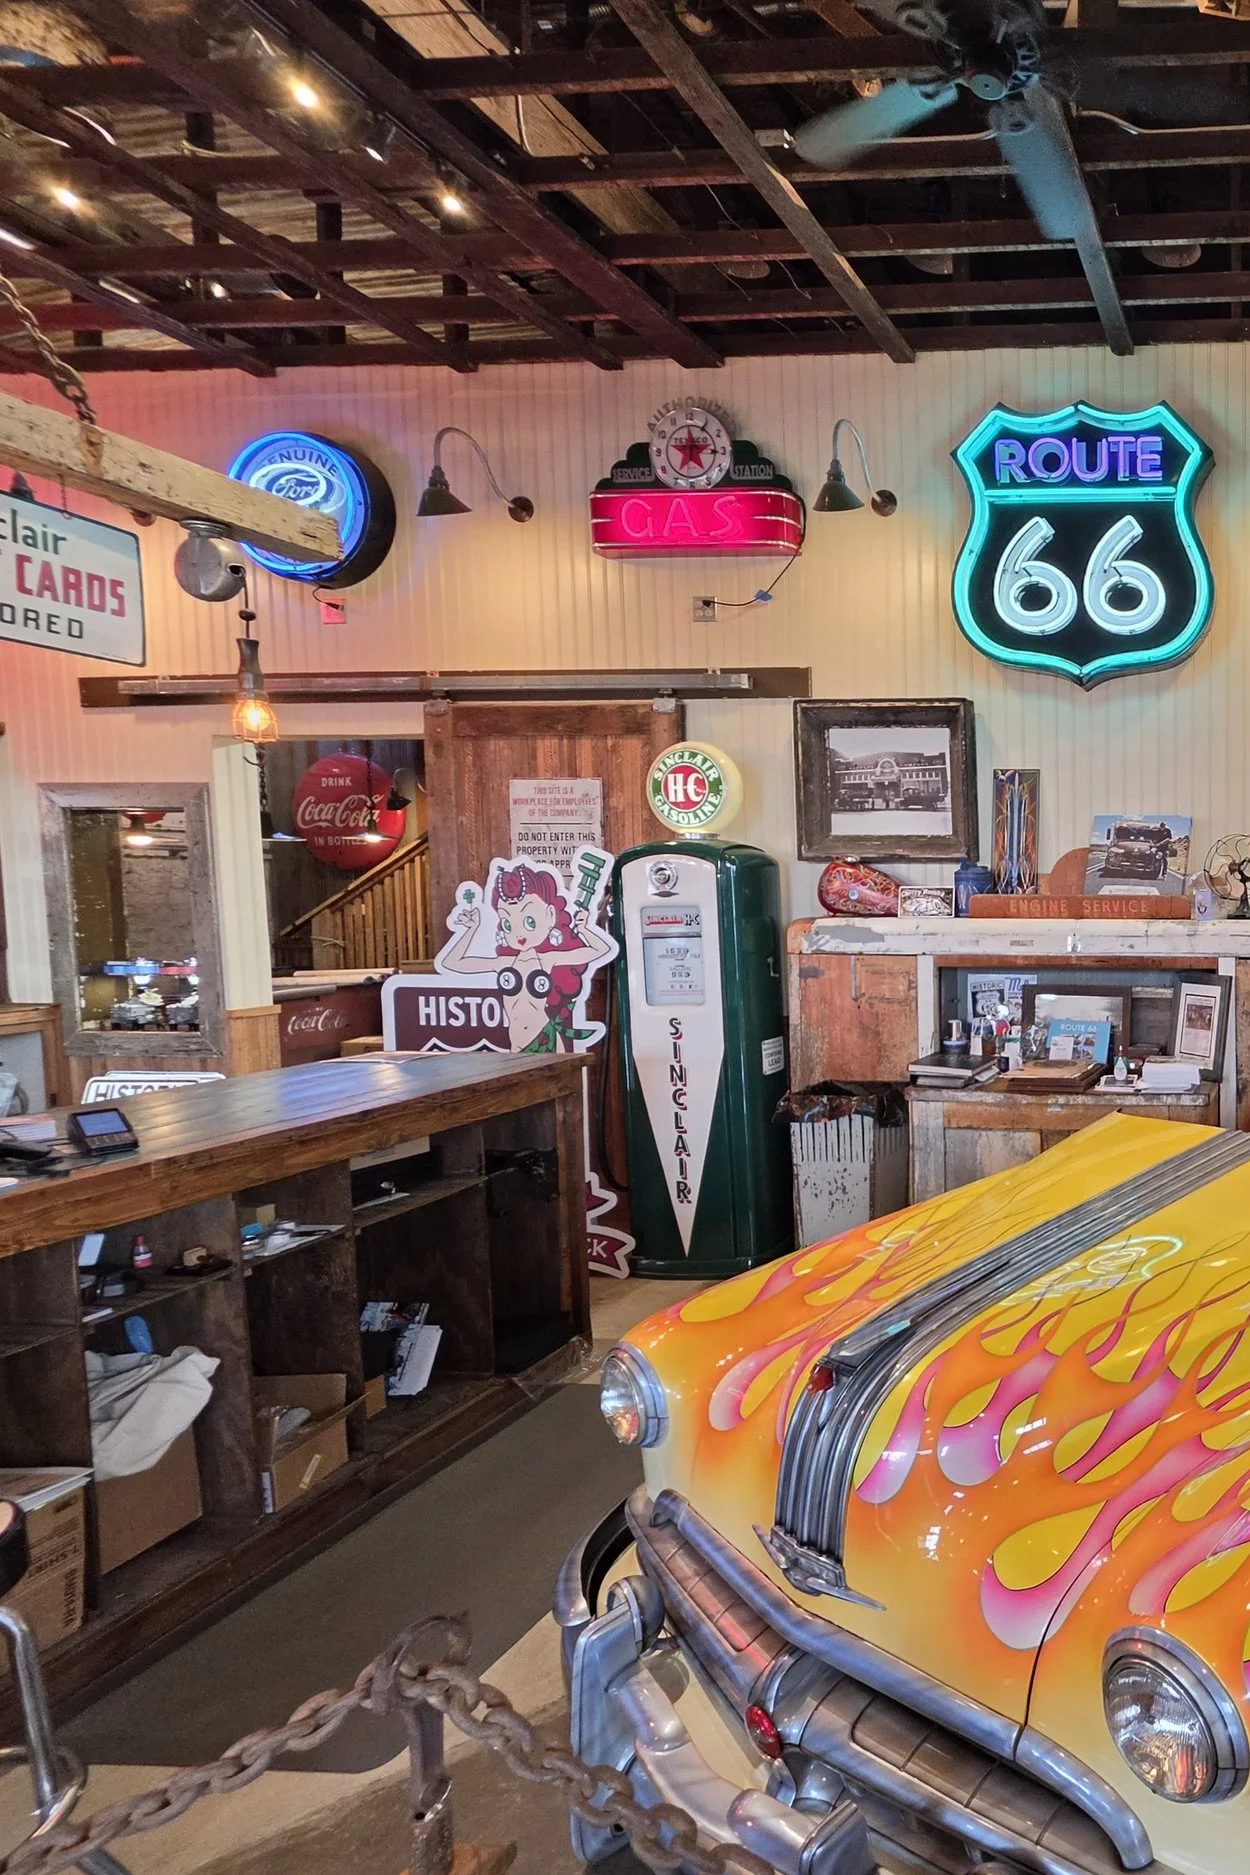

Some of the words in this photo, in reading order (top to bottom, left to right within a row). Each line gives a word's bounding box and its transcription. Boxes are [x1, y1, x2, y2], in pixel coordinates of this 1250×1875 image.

[262, 449, 339, 477] ENUINE
[994, 435, 1164, 484] ROUTE
[613, 467, 651, 481] SERVICE
[733, 464, 774, 478] STATION
[620, 496, 743, 537] GAS
[15, 553, 126, 618] CARDS
[993, 514, 1167, 636] 66
[654, 751, 719, 781] SINCLAIR
[321, 777, 352, 787] DRINK
[655, 793, 720, 824] GASOLINE
[314, 836, 325, 846] IN
[518, 832, 529, 841] DO
[531, 832, 547, 841] NOT
[549, 832, 575, 841] ENTER
[578, 832, 596, 841] THIS
[516, 846, 558, 855] PROPERTY
[561, 846, 578, 855] WIT
[1009, 899, 1068, 912] ENGINE
[1083, 899, 1150, 913] SERVICE
[972, 981, 1003, 990] HISTORIC
[1060, 1023, 1085, 1031] ROUTE
[1087, 1024, 1097, 1033] 66
[669, 1017, 692, 1204] SINCLAIR
